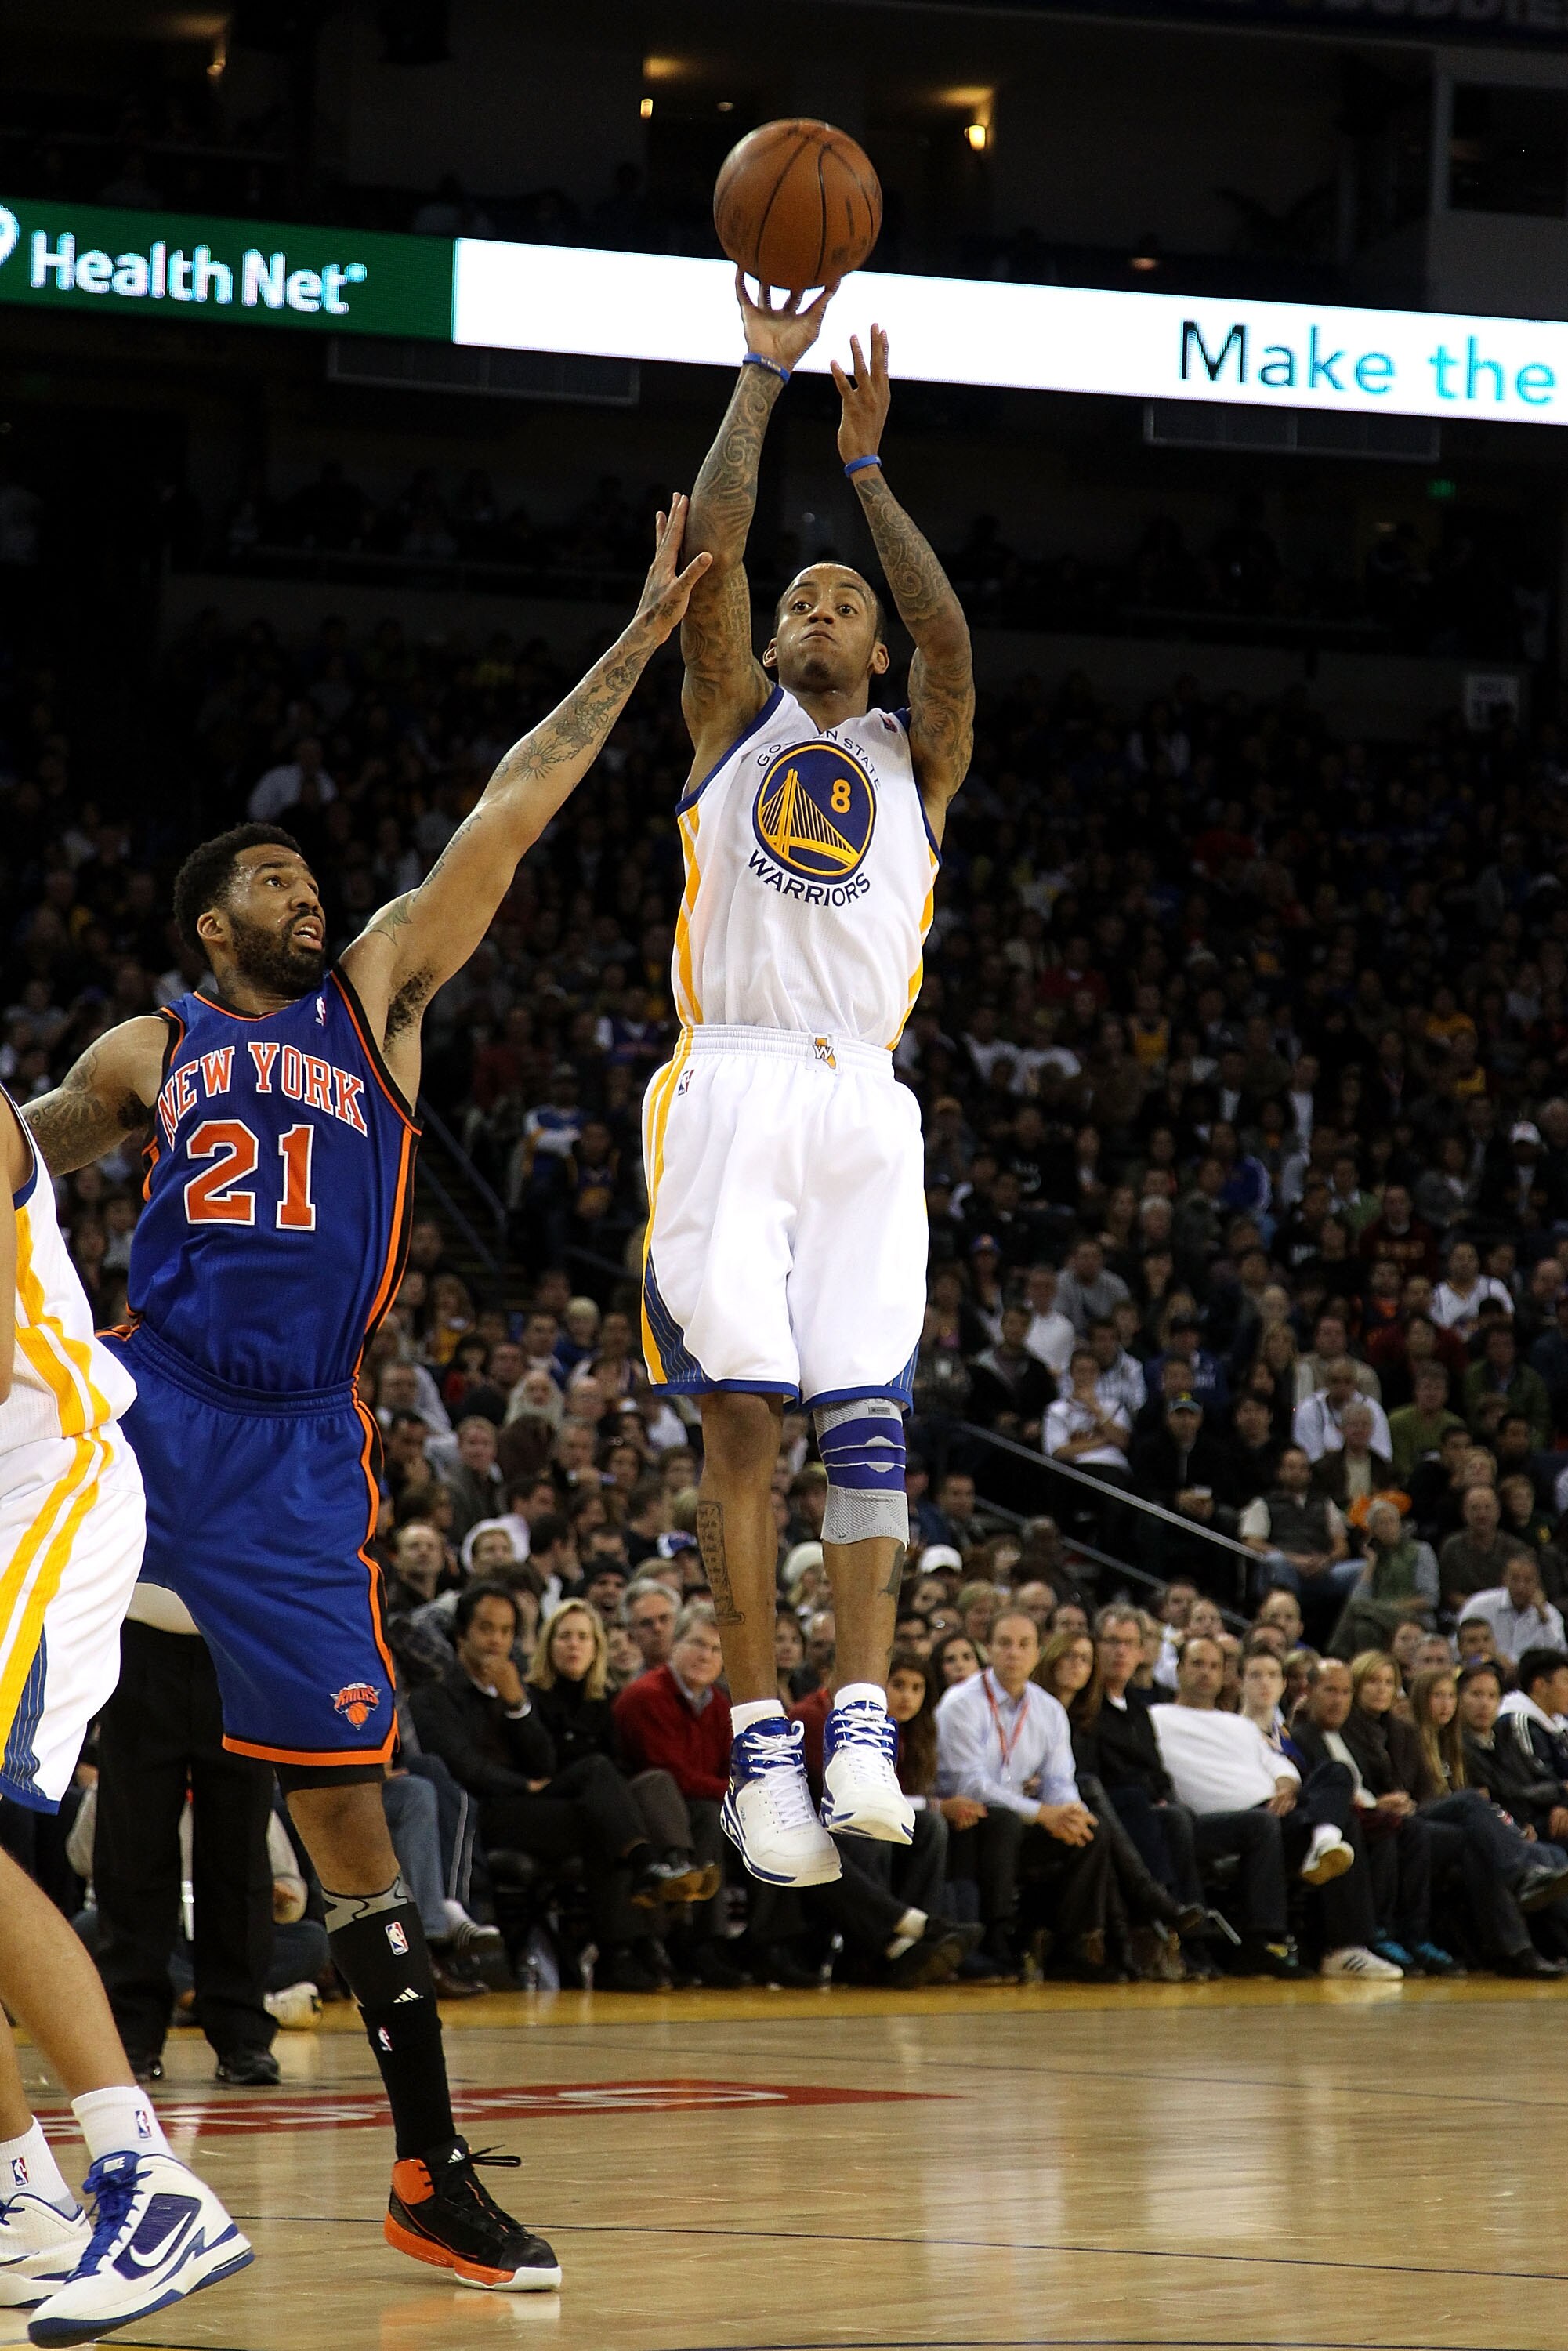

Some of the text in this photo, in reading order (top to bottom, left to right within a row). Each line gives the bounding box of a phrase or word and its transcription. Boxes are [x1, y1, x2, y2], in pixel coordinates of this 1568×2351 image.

[30, 230, 234, 304] Health
[1180, 319, 1558, 406] Make the
[831, 778, 852, 813] 8
[843, 737, 882, 791] STATE
[748, 849, 871, 907] WARRIORS
[157, 1041, 368, 1152] NEW YORK
[183, 1119, 316, 1231] 21
